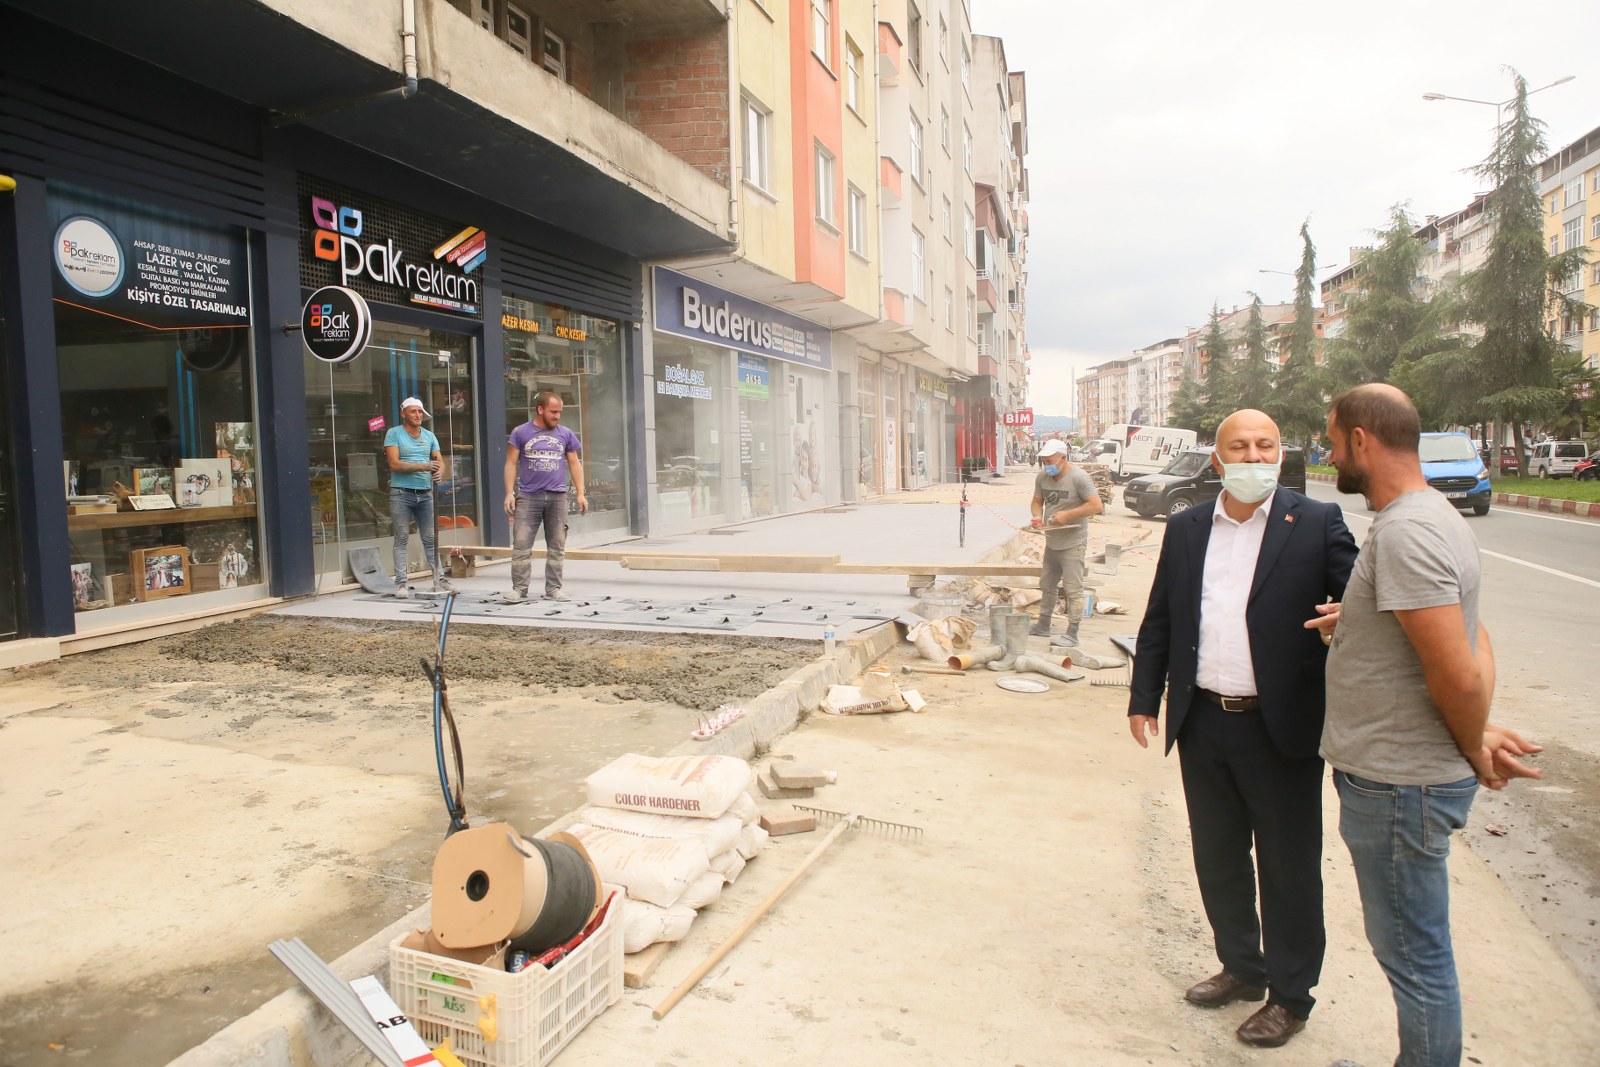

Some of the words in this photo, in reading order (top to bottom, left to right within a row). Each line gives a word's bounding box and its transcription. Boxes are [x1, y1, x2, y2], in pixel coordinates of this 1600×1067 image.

[146, 251, 177, 268] LAZER
[179, 260, 193, 271] ve
[195, 262, 219, 275] CNC
[341, 235, 404, 286] pak
[405, 263, 477, 302] reklam
[149, 281, 190, 295] PROMOSYON
[127, 286, 161, 305] KİŞİYE
[163, 291, 189, 309] ÖZEL
[190, 298, 248, 318] TASARIMLAR
[321, 311, 350, 334] pak
[682, 285, 772, 350] Buderus
[323, 329, 350, 338] reklam
[555, 325, 569, 339] CNC
[665, 363, 705, 386] DOĞALGAZ
[615, 792, 647, 807] COLOR
[648, 796, 701, 812] HARDENER
